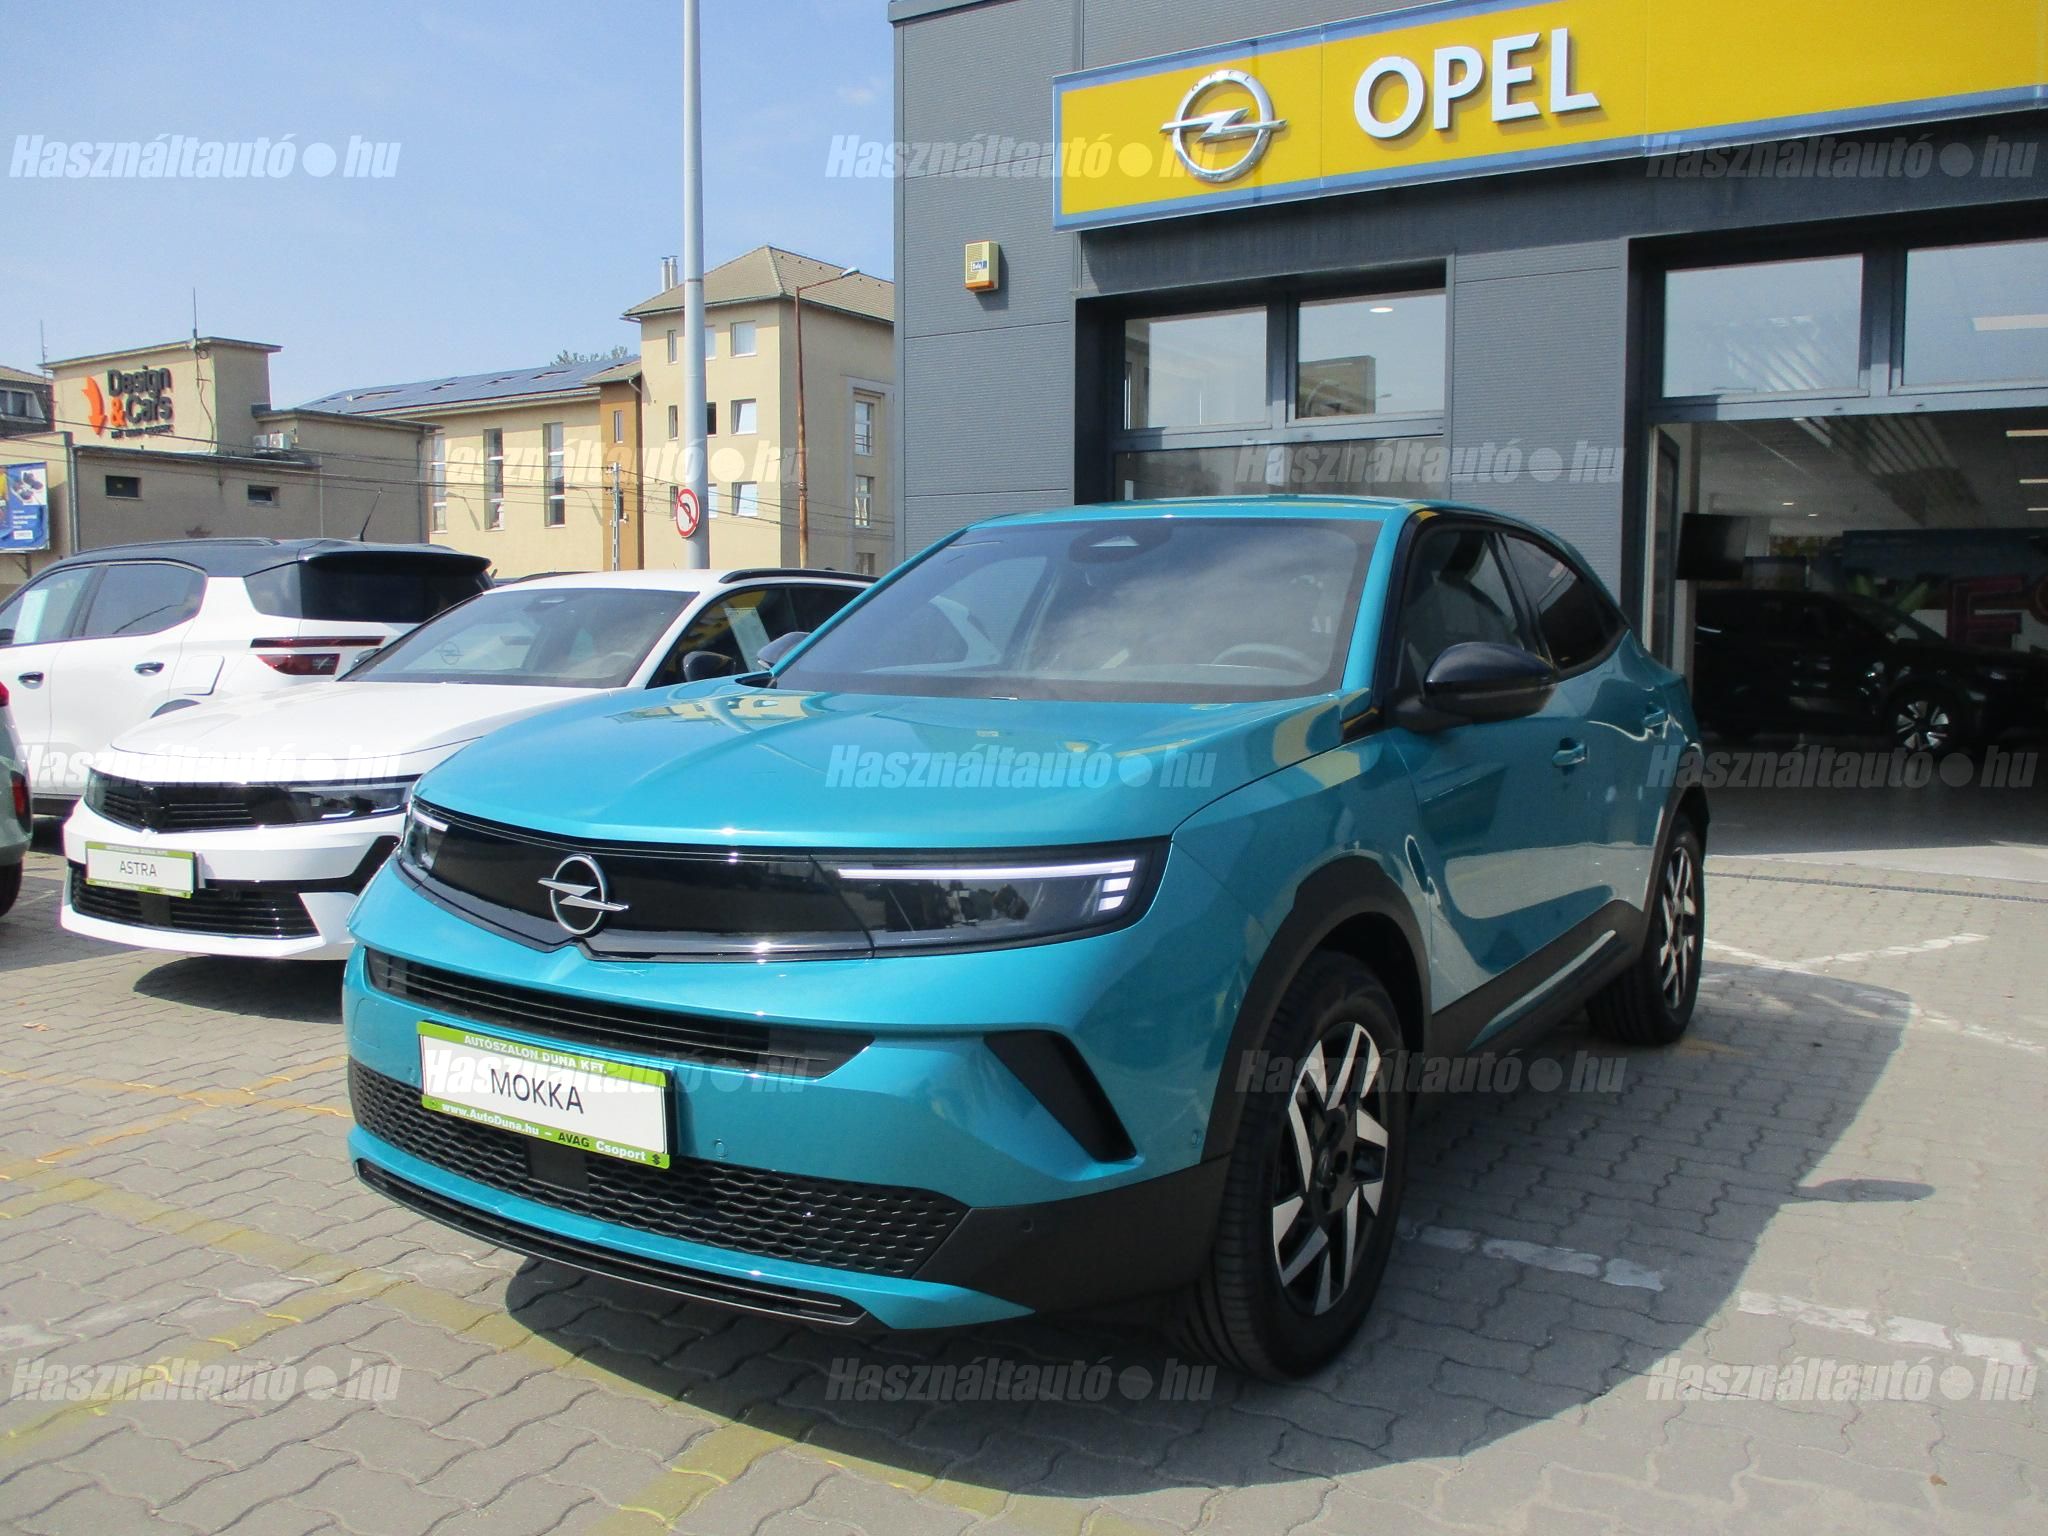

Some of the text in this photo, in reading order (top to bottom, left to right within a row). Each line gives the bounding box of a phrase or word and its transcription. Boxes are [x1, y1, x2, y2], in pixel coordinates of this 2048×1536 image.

[1354, 28, 1600, 139] OPEL
[108, 365, 172, 400] Design
[119, 860, 157, 877] ASTRA
[464, 1035, 608, 1075] AUTÓSZALON DUNA KFT.
[490, 1068, 584, 1115] MOKKA
[441, 1103, 540, 1137] www.AutoDuna.hu
[558, 1131, 590, 1149] AVAG
[595, 1140, 647, 1163] Csoport
